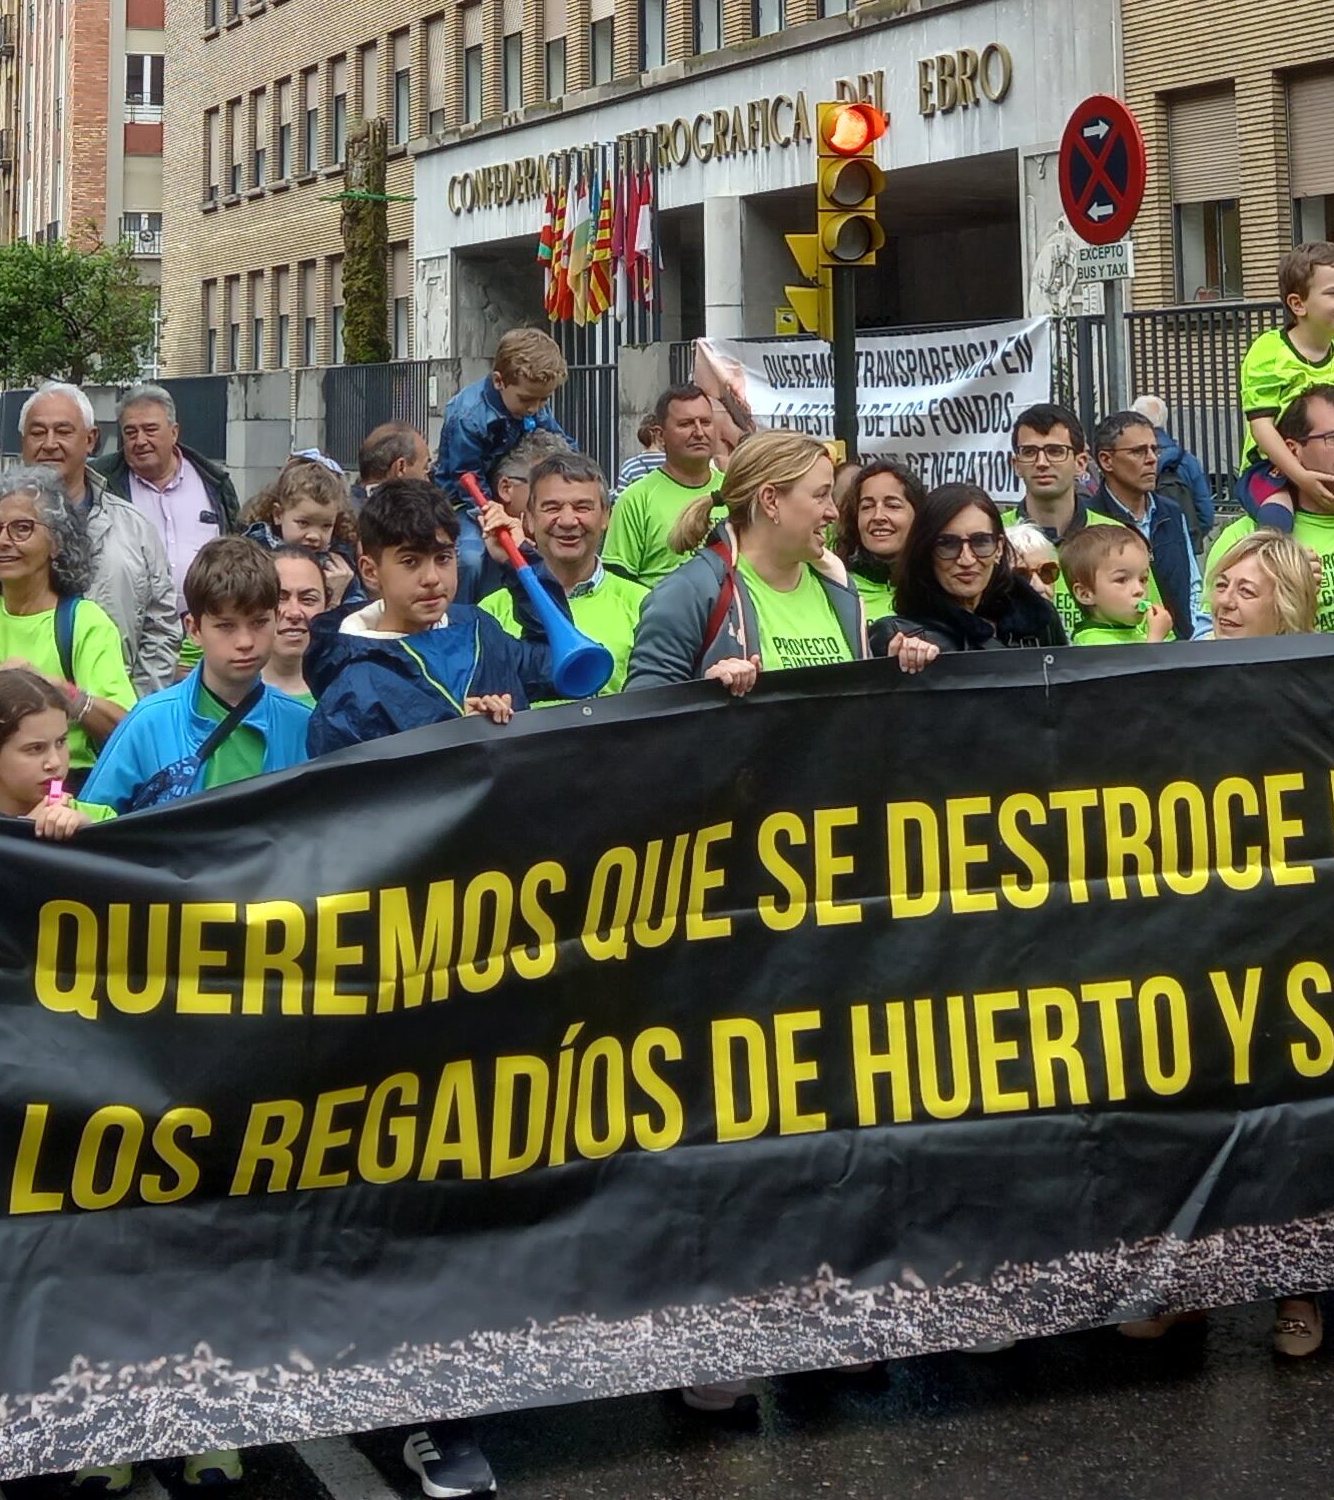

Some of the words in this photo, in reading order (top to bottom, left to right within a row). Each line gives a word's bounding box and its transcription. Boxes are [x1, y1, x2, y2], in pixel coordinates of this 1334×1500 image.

[917, 42, 1013, 117] EBRO
[1077, 265, 1097, 279] BUS
[1098, 264, 1105, 278] Y
[1107, 262, 1128, 277] TAXI
[1079, 244, 1124, 261] EXCEPTO
[762, 351, 836, 391] QUEREMO
[854, 338, 999, 389] TRANSPARENCIA
[1001, 332, 1033, 375] EN
[864, 403, 891, 438] DE
[890, 399, 926, 438] LOS
[927, 391, 1015, 438] FONDOS
[772, 636, 840, 656] PROYECTO
[33, 860, 567, 1021] QUEREMOS
[579, 820, 733, 962] QUE
[757, 806, 863, 931] SE
[886, 771, 1315, 920] DESTROCE
[9, 1103, 212, 1216] LOS
[228, 1021, 684, 1197] REGADÍOS
[711, 1010, 827, 1143] DE
[851, 975, 1192, 1128] HUERTO
[1208, 967, 1262, 1085] Y
